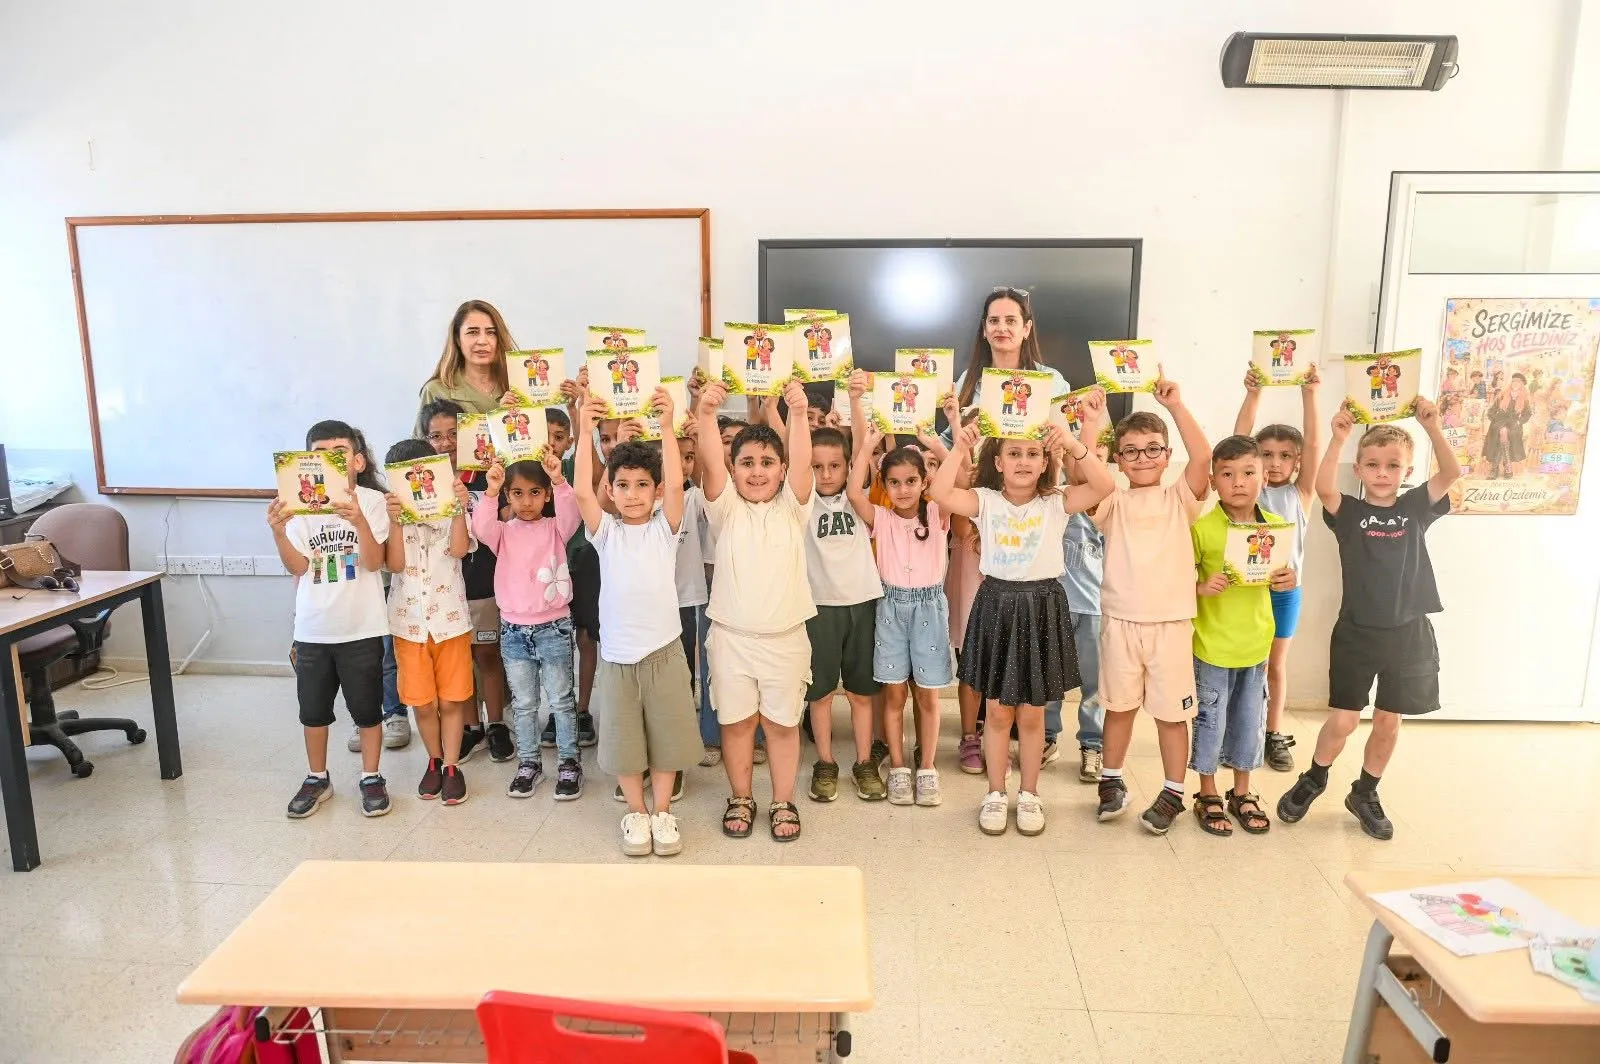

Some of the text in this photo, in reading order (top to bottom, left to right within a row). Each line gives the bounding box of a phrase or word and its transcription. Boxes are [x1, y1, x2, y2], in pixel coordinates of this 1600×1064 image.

[1464, 488, 1499, 503] Zehra
[817, 511, 856, 538] GAP
[1007, 516, 1042, 532] TODAY
[309, 530, 359, 550] SURVIVAL
[320, 544, 344, 553] MODE
